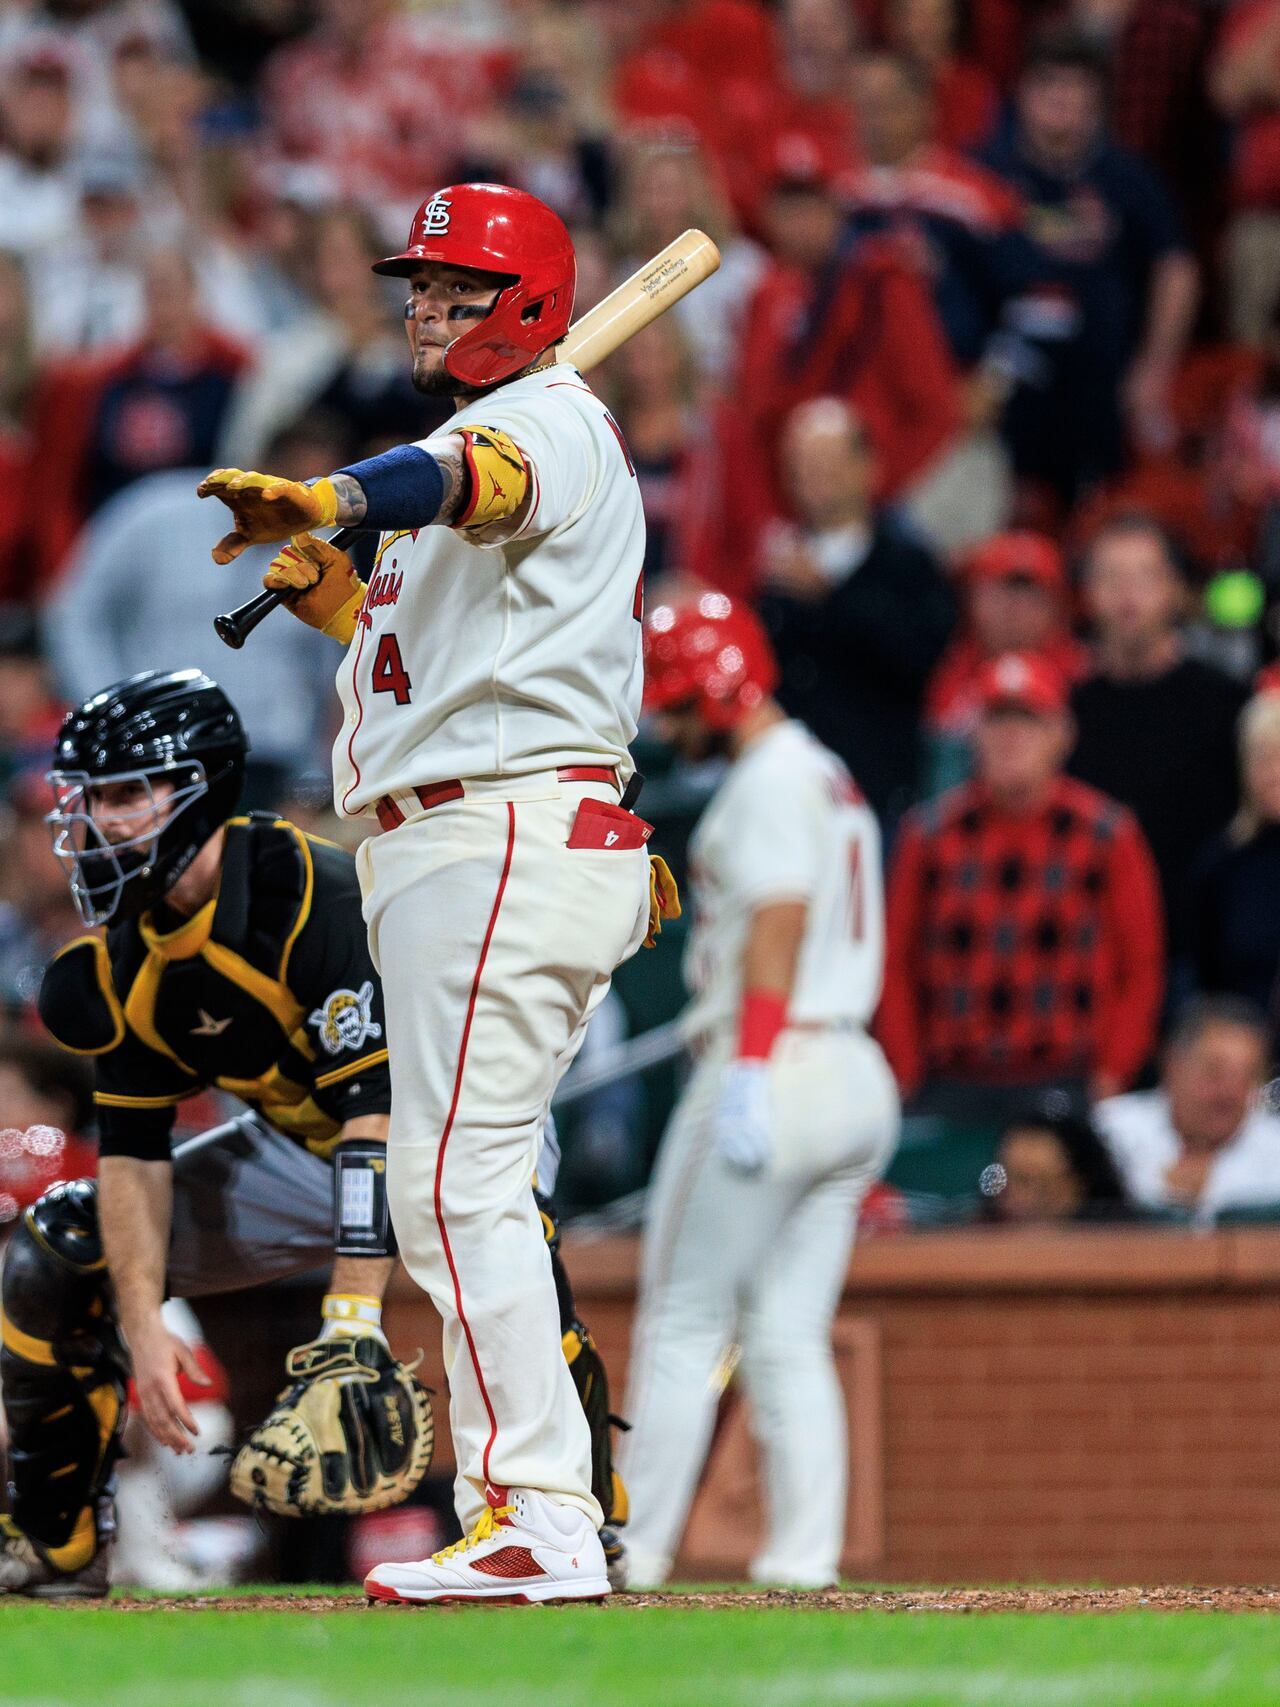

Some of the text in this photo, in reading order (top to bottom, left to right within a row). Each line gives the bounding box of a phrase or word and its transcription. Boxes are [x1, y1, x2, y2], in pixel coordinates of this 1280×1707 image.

[640, 275, 662, 294] Yadier
[660, 258, 685, 277] Molina
[372, 633, 412, 706] 4
[604, 830, 620, 847] 4
[571, 1557, 579, 1569] 4
